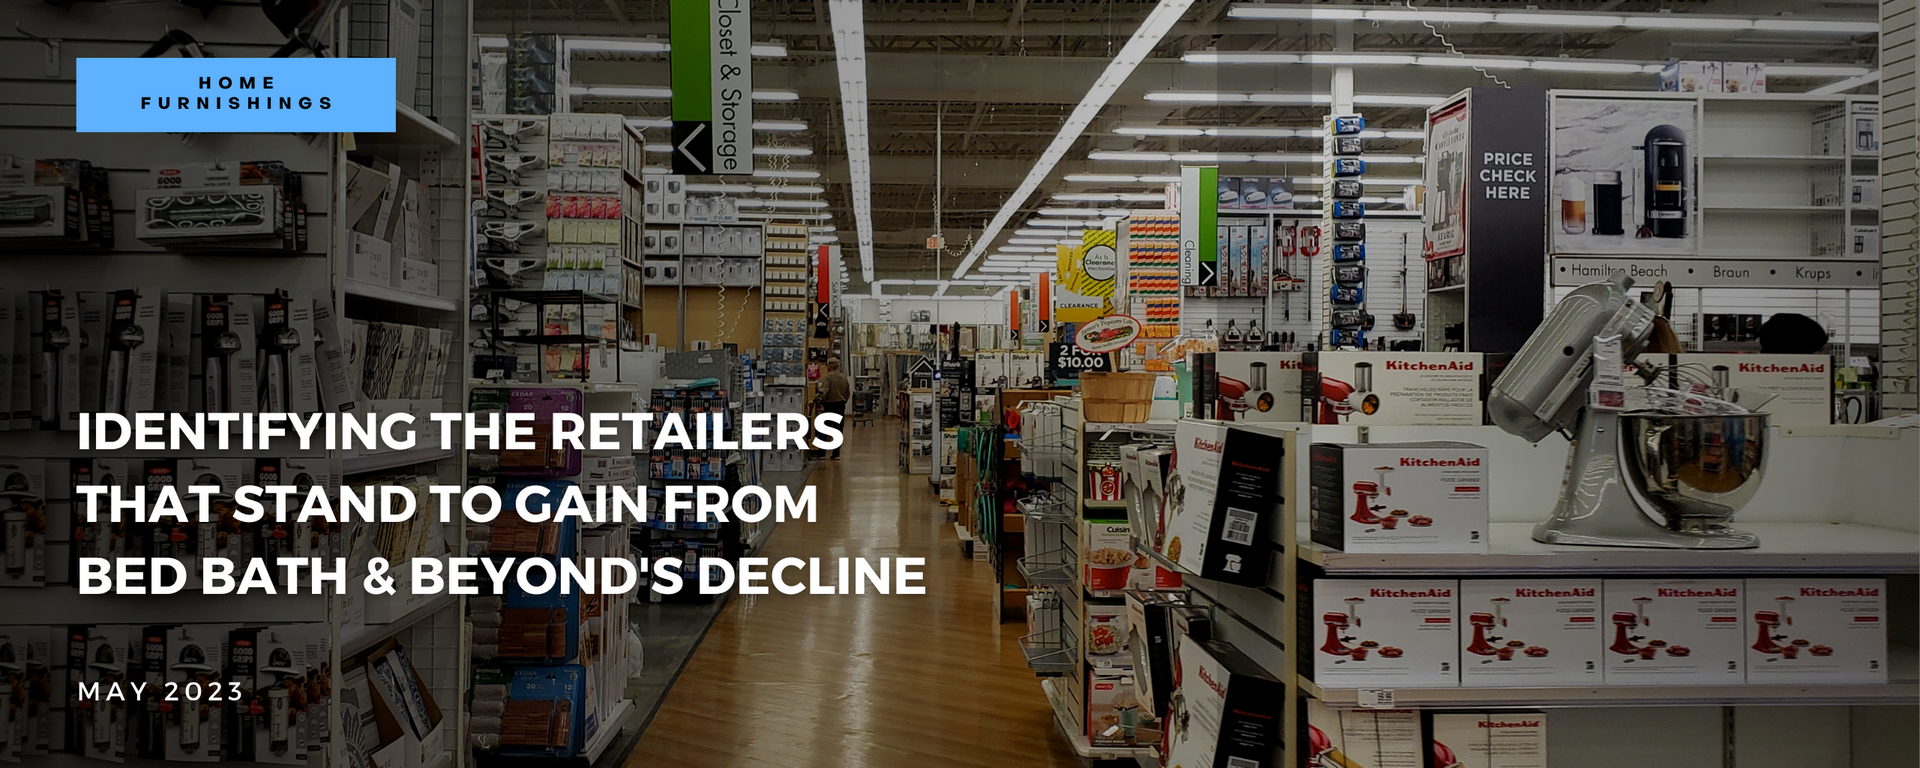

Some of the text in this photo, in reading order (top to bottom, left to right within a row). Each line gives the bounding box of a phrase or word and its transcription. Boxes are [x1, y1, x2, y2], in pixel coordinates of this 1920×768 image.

[720, 64, 742, 81] &
[716, 89, 742, 170] Storage
[1483, 152, 1534, 166] PRICE
[157, 177, 182, 185] GOOD
[1479, 169, 1537, 183] CHECK
[1485, 186, 1531, 200] HERE
[1182, 240, 1196, 284] Cleaning
[1631, 263, 1668, 278] Beach
[1713, 265, 1750, 279] Braun
[1795, 266, 1832, 282] Krups
[1060, 345, 1069, 356] 2
[1057, 356, 1105, 369] $10.00
[1280, 360, 1303, 370] Kit
[1386, 361, 1473, 371] KitchenAid
[1739, 363, 1824, 373] KitchenAid
[1400, 457, 1480, 467] KitchenAid
[147, 475, 173, 483] GOOD
[259, 473, 278, 481] GOOD
[1370, 588, 1451, 597] KitchenAid
[1516, 588, 1595, 597] KitchenAid
[1658, 588, 1736, 597] KitchenAid
[1800, 588, 1878, 596] KitchenAid
[232, 647, 254, 656] GOOD
[232, 655, 254, 664] GRIPS
